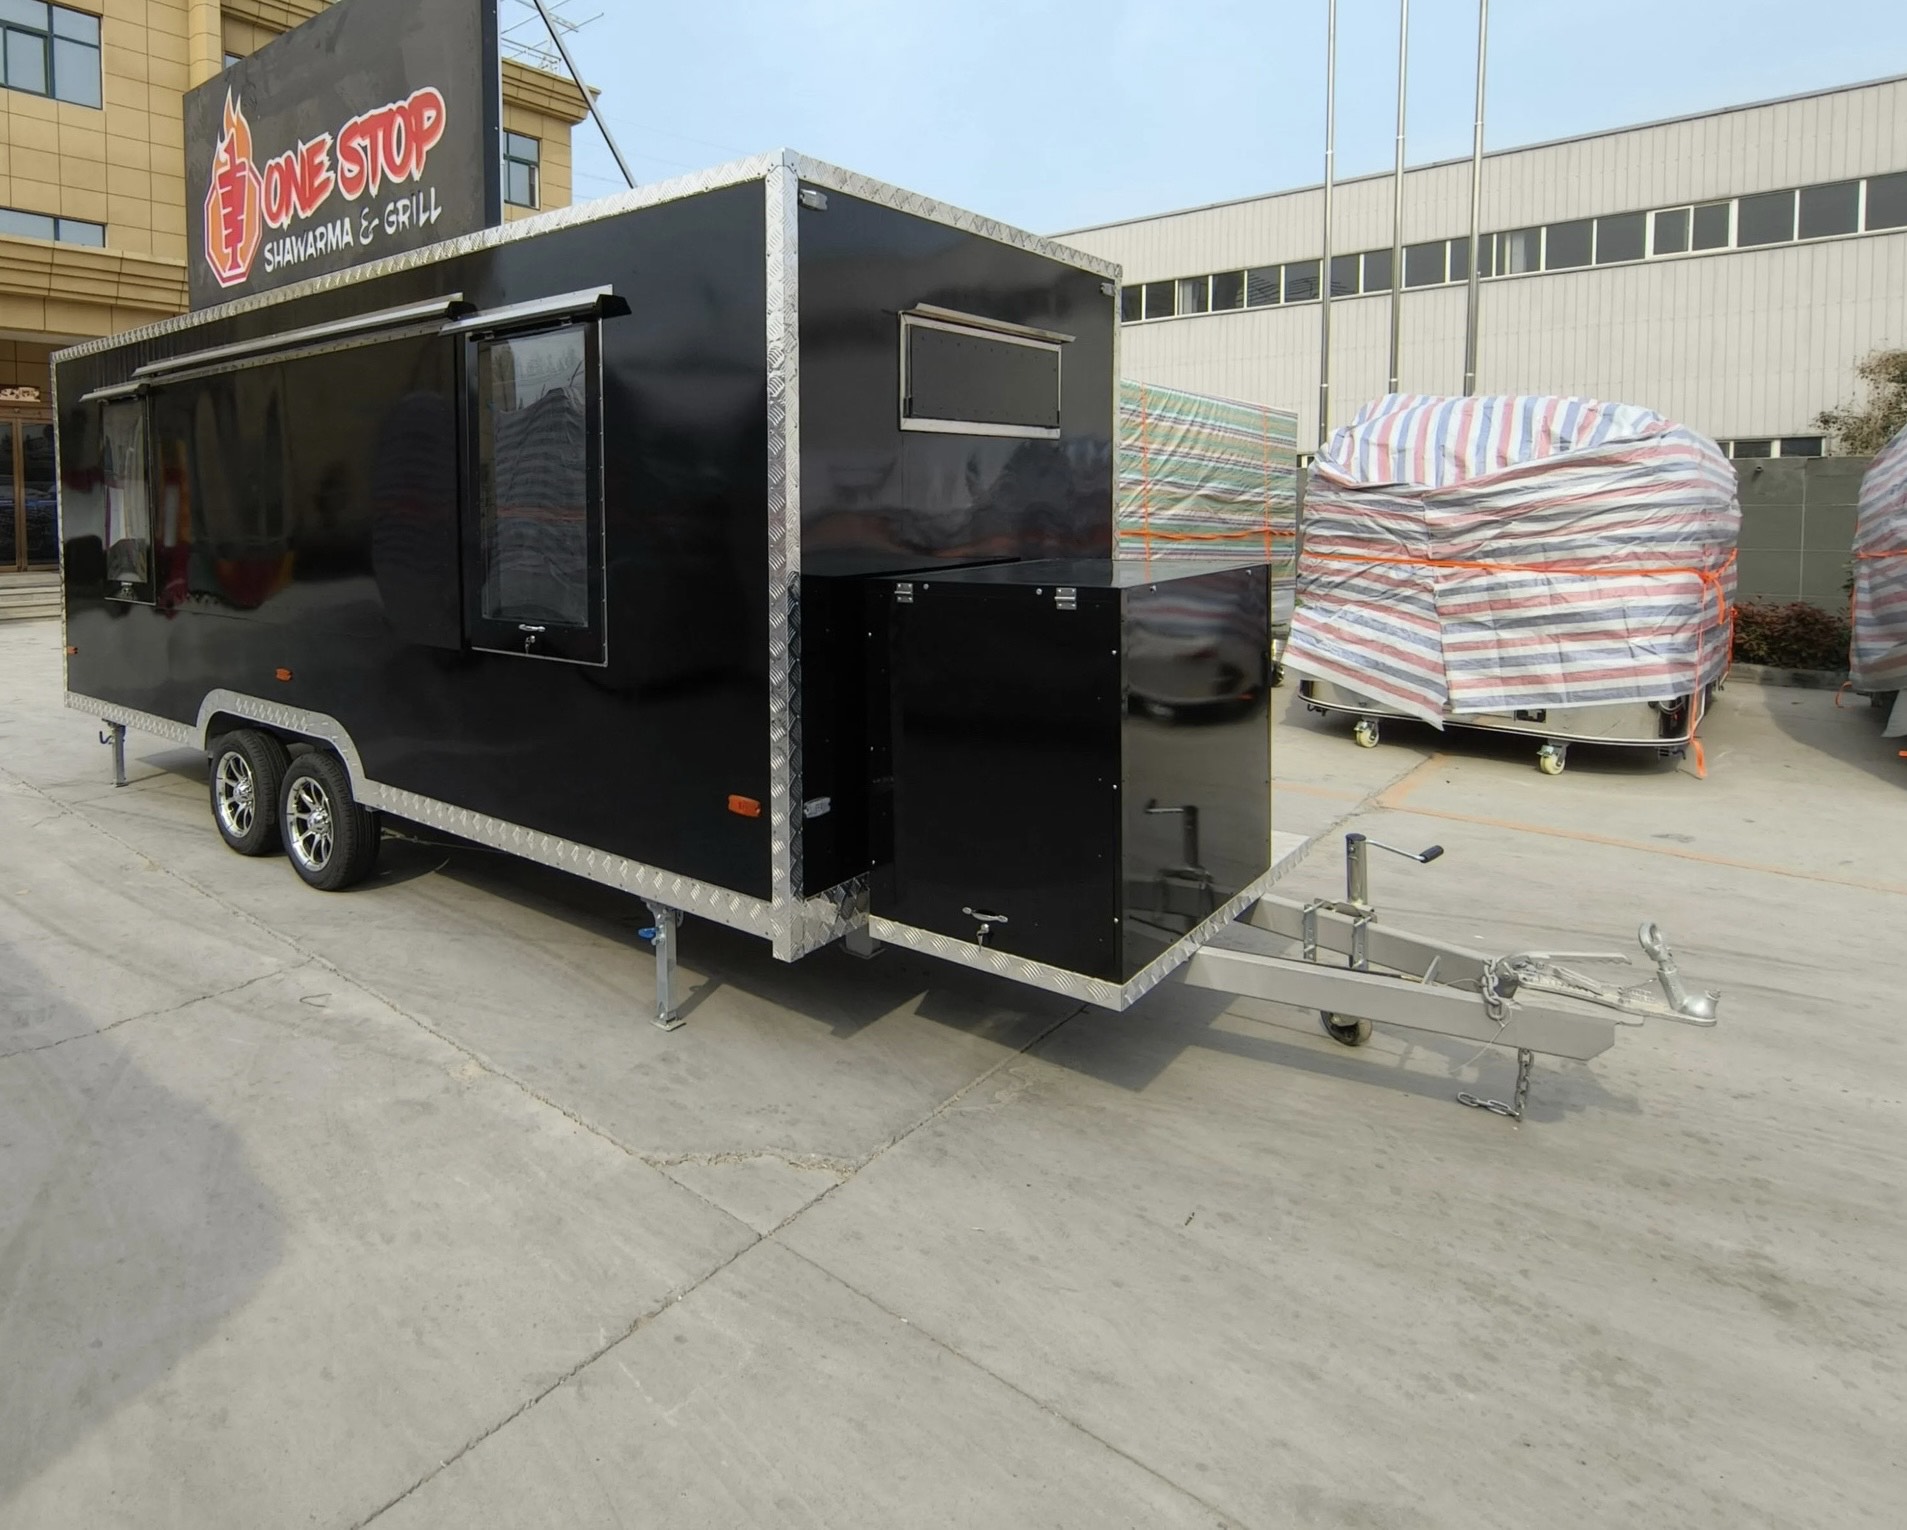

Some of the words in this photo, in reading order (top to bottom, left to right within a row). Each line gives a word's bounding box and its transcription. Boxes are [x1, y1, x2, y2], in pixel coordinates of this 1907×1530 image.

[261, 132, 335, 230] ONE
[337, 87, 446, 200] STOP
[264, 217, 354, 273] SHAWARMA
[359, 206, 379, 246] &
[384, 187, 442, 234] GRILL
